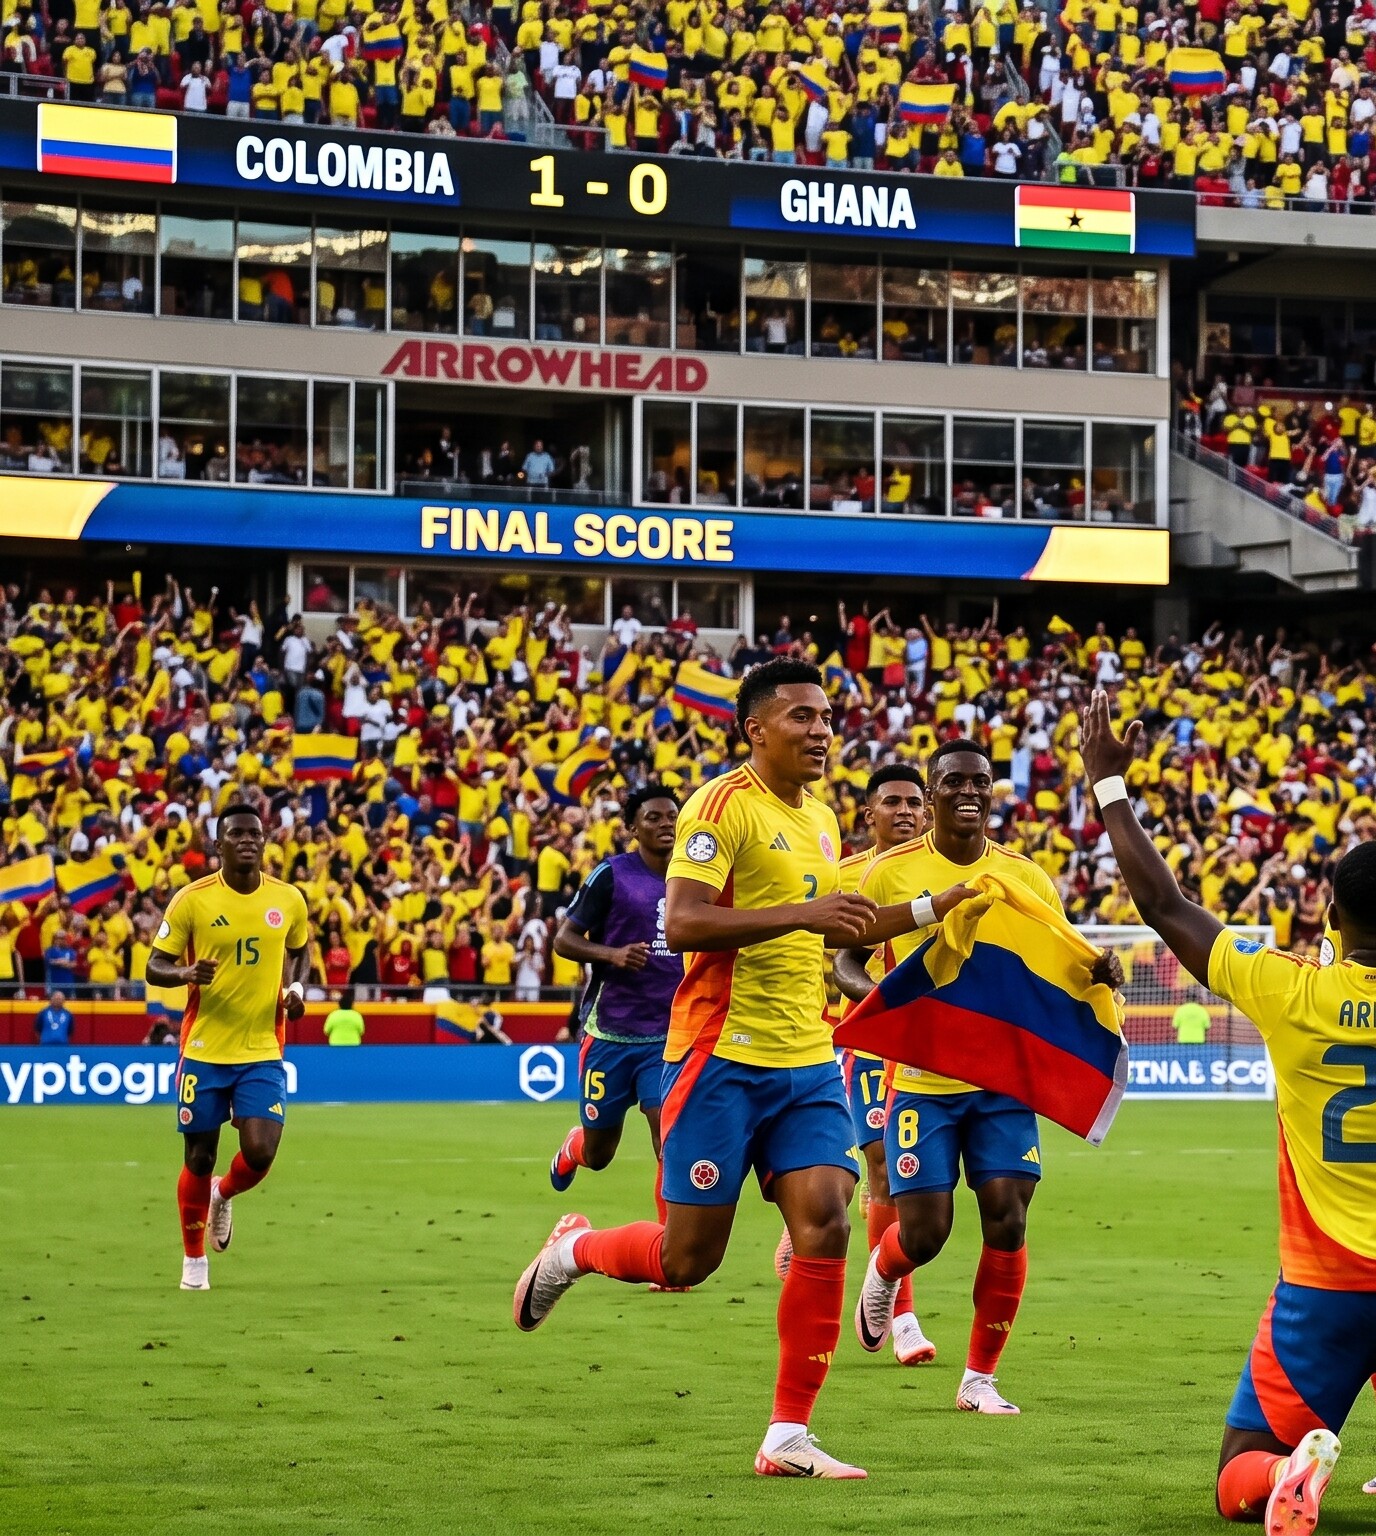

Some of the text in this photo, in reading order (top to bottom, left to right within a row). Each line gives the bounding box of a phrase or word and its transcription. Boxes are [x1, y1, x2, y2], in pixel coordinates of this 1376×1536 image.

[236, 135, 456, 196] COLOMBIA
[530, 155, 564, 207] 1
[628, 162, 669, 215] 0
[781, 179, 917, 230] GHANA
[381, 341, 708, 392] ARROWHEAD
[421, 506, 734, 562] FINAL SCORE
[235, 936, 261, 966] 15
[179, 1072, 198, 1104] 18
[584, 1068, 606, 1100] 15
[859, 1069, 887, 1106] 17
[898, 1109, 919, 1149] 8
